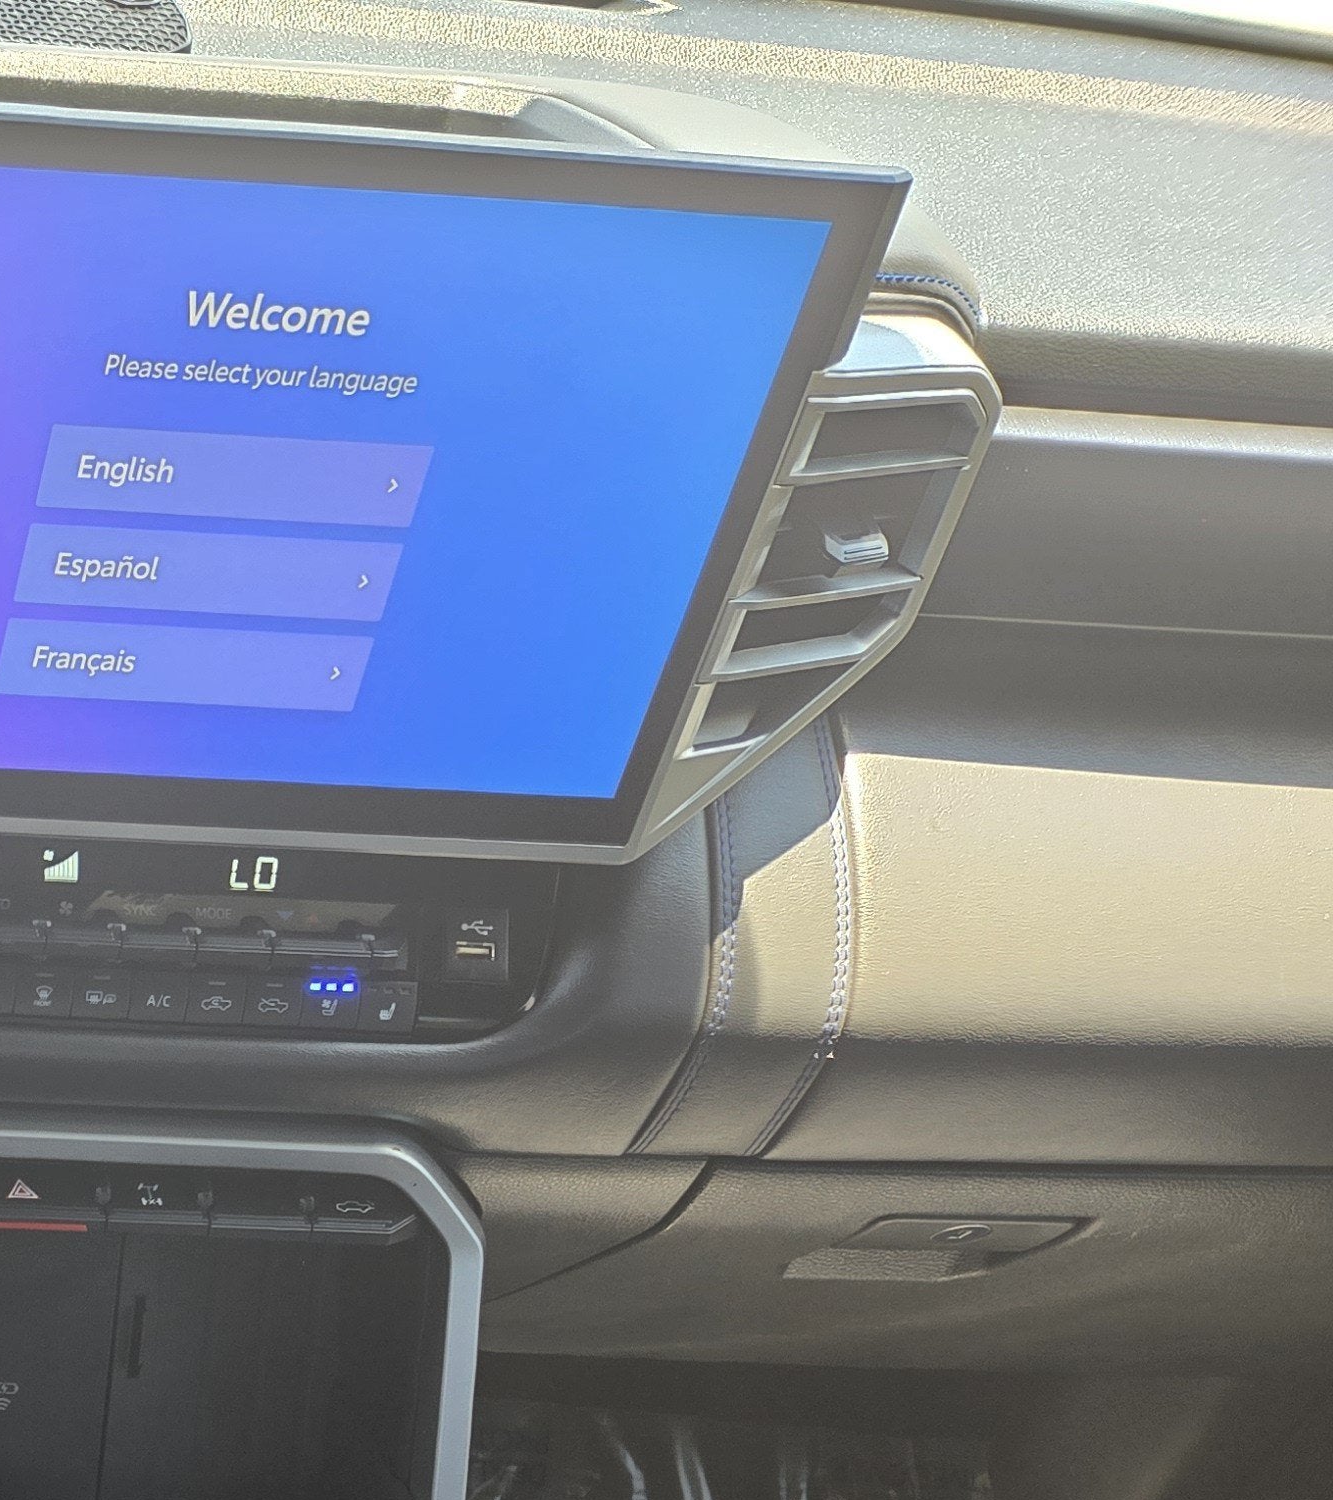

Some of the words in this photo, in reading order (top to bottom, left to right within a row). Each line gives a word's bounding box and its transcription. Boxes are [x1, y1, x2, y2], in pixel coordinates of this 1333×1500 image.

[186, 290, 371, 337] Welcome
[104, 354, 179, 382] Please
[182, 359, 251, 385] select
[251, 368, 307, 390] your
[309, 365, 418, 398] language
[76, 454, 174, 487] English
[54, 551, 159, 582] Español
[31, 645, 136, 676] Français
[229, 856, 279, 890] LO
[123, 904, 157, 916] SYNC
[195, 907, 232, 920] MODE
[146, 994, 172, 1008] A/C
